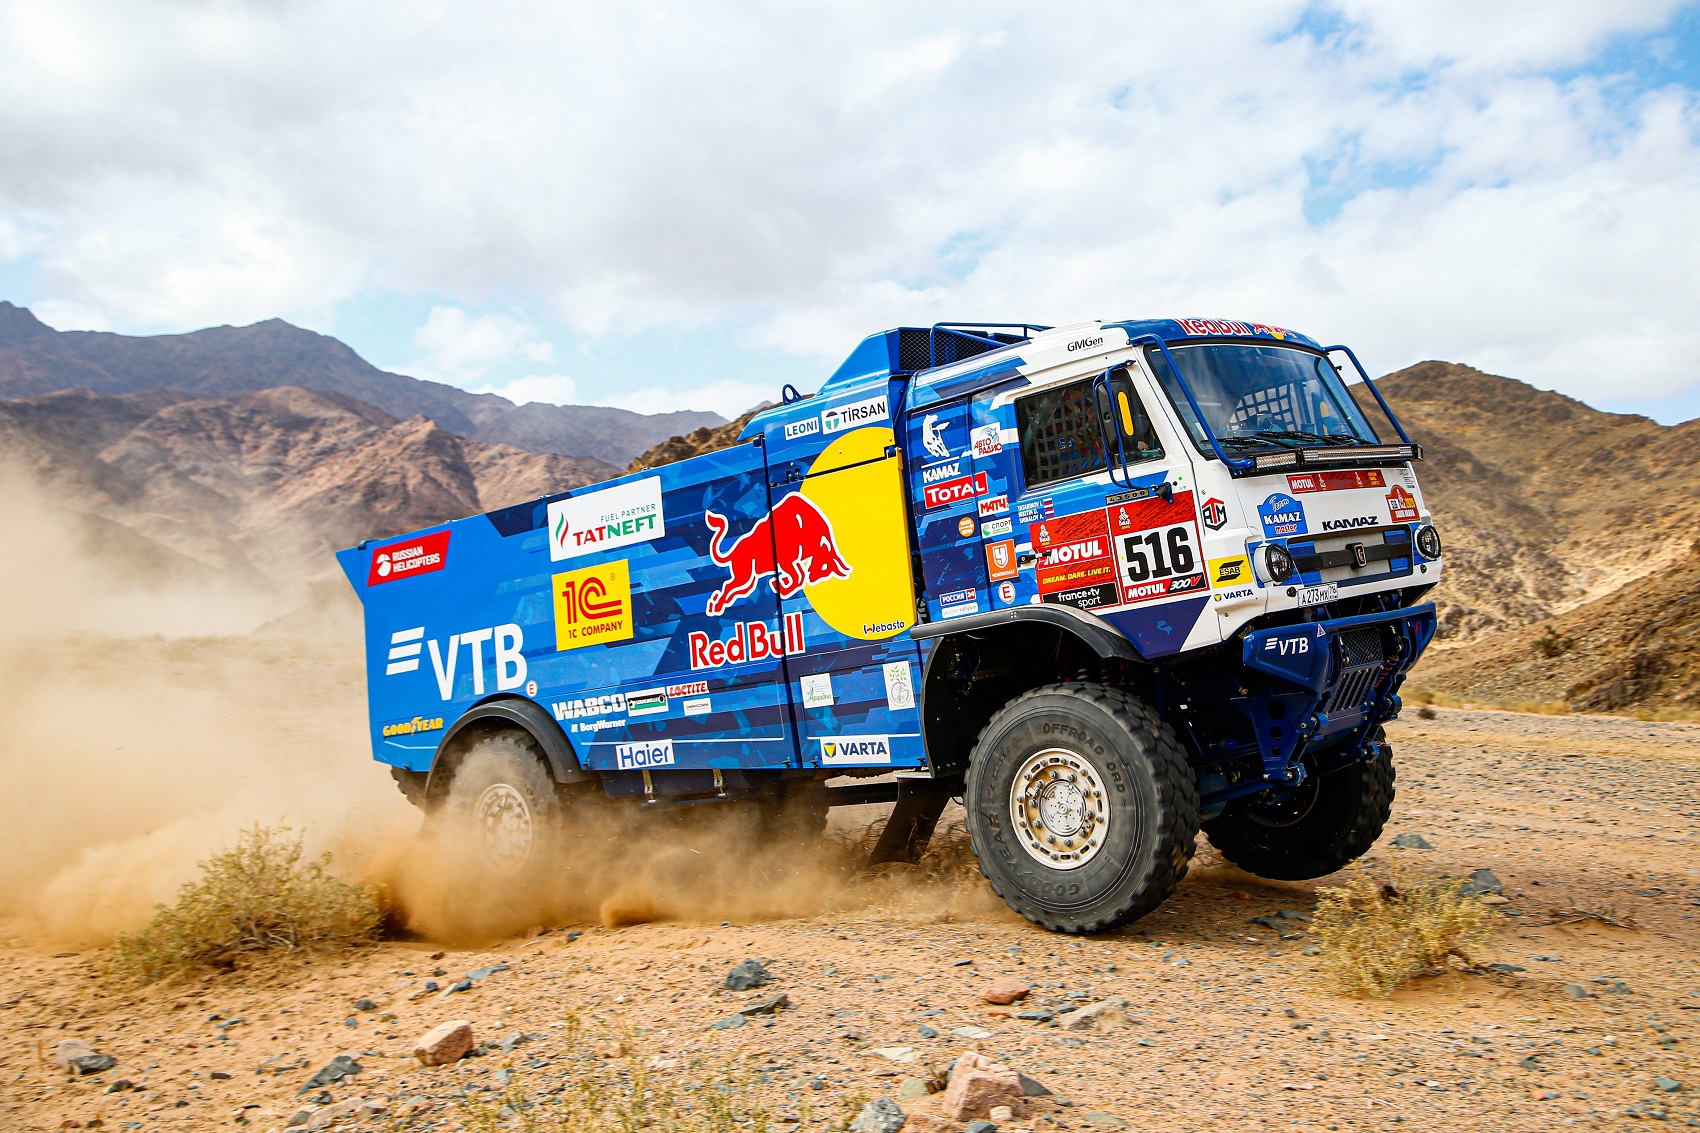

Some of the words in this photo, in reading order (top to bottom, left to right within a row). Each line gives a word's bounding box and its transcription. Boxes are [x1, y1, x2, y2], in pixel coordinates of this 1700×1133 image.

[1067, 336, 1104, 352] GMGen
[787, 420, 818, 437] LEONI
[923, 463, 961, 483] KAMAZ
[927, 481, 985, 503] TOTAL
[1291, 479, 1314, 489] MOTUL
[601, 513, 619, 523] FUEL
[622, 503, 656, 518] PARTNER
[1263, 511, 1302, 525] KAMAZ
[573, 513, 657, 547] TATNEFT
[992, 520, 1011, 529] СПОРТ
[1275, 524, 1297, 534] master
[1322, 515, 1378, 531] KAMAZ
[392, 546, 423, 561] RUSSIAN
[1044, 540, 1103, 566] MOTUL
[1124, 526, 1195, 583] 516
[392, 553, 441, 573] HELICOPTERS
[1219, 566, 1240, 576] ESAB
[1043, 575, 1067, 585] DREAM.
[1088, 568, 1102, 576] LIVE
[1128, 583, 1166, 599] MOTUL
[1169, 575, 1203, 590] 300V
[1223, 588, 1254, 600] VARTA
[942, 592, 965, 603] РОССИЯ
[966, 590, 975, 599] 24
[1078, 596, 1102, 610] sport
[568, 629, 577, 639] 1C
[582, 620, 623, 637] COMPANY
[863, 620, 905, 636] Webasto
[1279, 637, 1309, 656] VTB
[427, 623, 528, 701] VTB
[668, 682, 707, 697] LOCTITE
[552, 693, 626, 721] WABCO
[383, 717, 443, 736] GOODYEAR
[580, 719, 626, 733] BorgWarner
[1042, 722, 1105, 754] OFFROAD
[619, 744, 669, 767] Haier
[839, 741, 887, 756] VARTA
[1106, 762, 1126, 794] ORD
